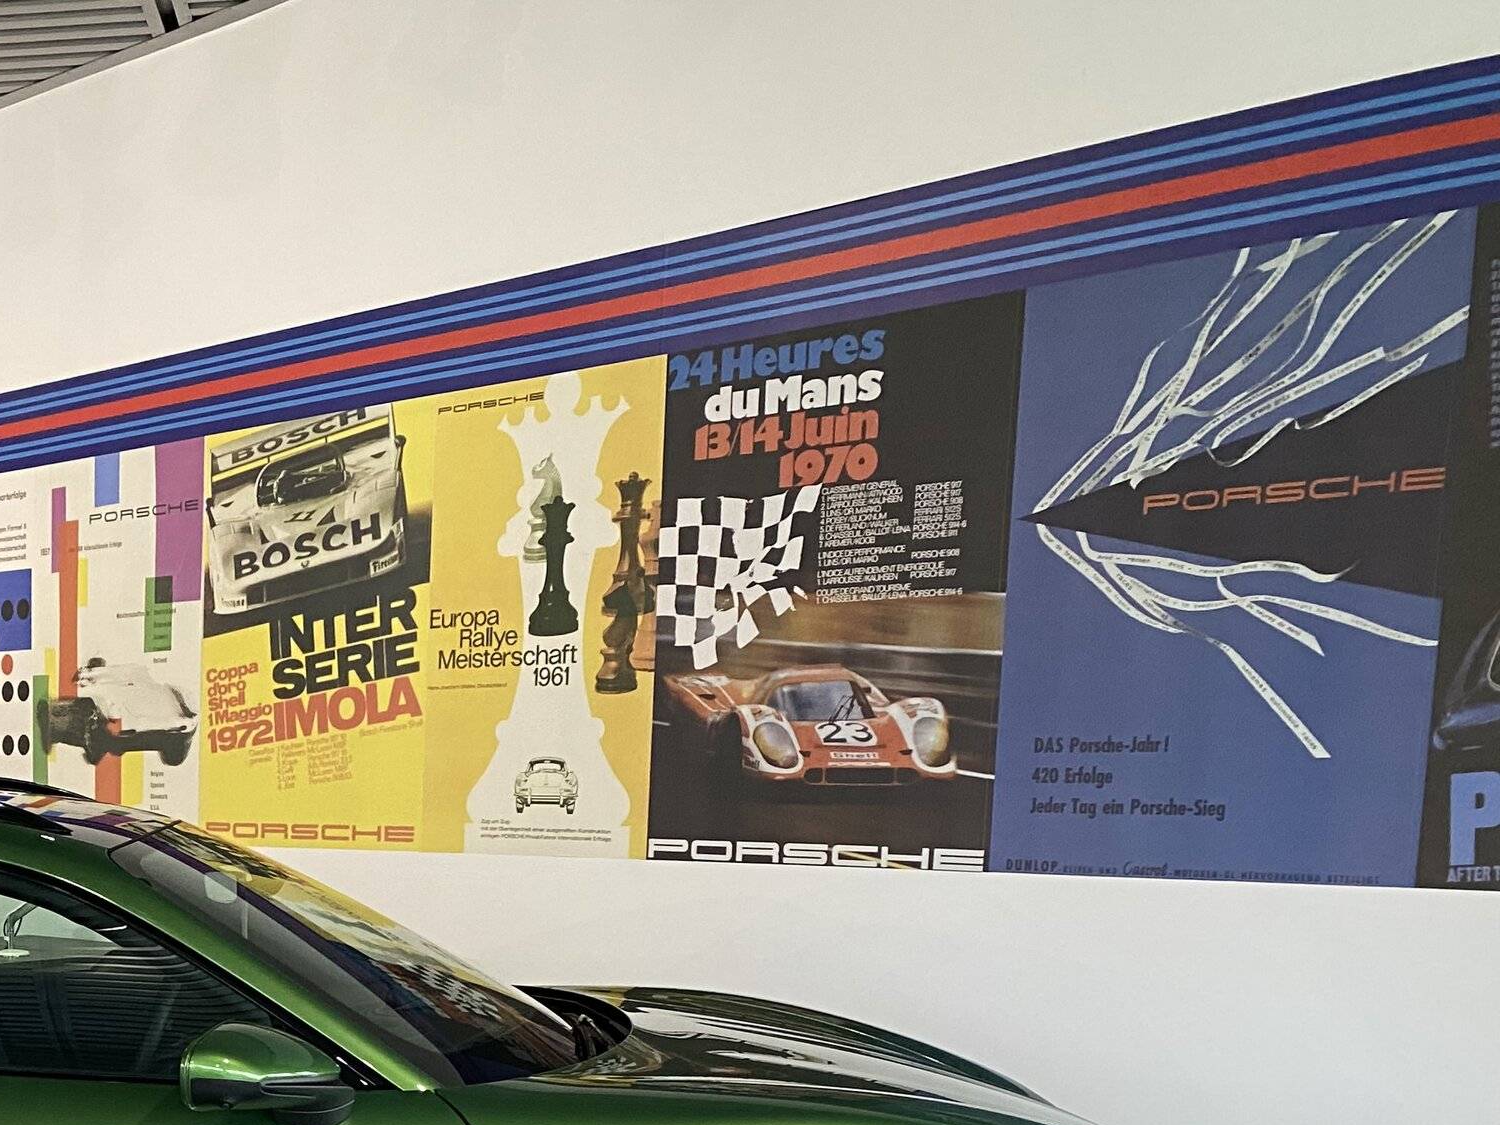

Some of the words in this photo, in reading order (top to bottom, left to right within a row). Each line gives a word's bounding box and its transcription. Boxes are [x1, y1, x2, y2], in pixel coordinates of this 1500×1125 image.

[667, 350, 717, 391] 24
[720, 329, 886, 383] Heures
[437, 391, 545, 415] PORSCHE
[704, 385, 760, 423] du
[764, 369, 885, 416] Mans
[230, 407, 368, 465] BOSCH
[693, 415, 784, 461] 13/14
[783, 405, 880, 450] Juin
[778, 442, 879, 489] 1970
[914, 490, 950, 501] PORSCHE
[915, 482, 950, 493] PORSCHE
[1142, 467, 1447, 516] PORSCHE
[88, 499, 200, 525] PORSCHE
[914, 498, 950, 509] PORSCHE
[912, 521, 949, 532] PORSCHE
[912, 529, 948, 540] PORSCHE
[233, 512, 382, 581] BOSCH
[911, 549, 946, 559] PORSCHE
[910, 569, 945, 579] PORSCHE
[909, 588, 945, 598] PORSCHE
[268, 585, 419, 662] INTER
[429, 608, 500, 631] Europa
[459, 627, 519, 651] Rallye
[271, 631, 421, 700] SERIE
[438, 643, 578, 670] Meisterschaft
[206, 662, 259, 683] Coppa
[533, 666, 570, 687] 1961
[208, 691, 246, 712] Shell
[273, 675, 423, 742] IMOLA
[214, 703, 273, 725] Maggio
[207, 719, 274, 754] 1972
[818, 722, 874, 744] 23
[1033, 737, 1063, 754] DAS
[1031, 767, 1059, 784] 420
[1064, 765, 1113, 789] Erfolge
[1030, 797, 1067, 815] Jeder
[1071, 798, 1097, 819] Tag
[1102, 799, 1124, 815] ein
[1130, 797, 1227, 822] Porsche-Sieg
[205, 821, 416, 843] PORSCHE
[647, 838, 986, 872] PORSCHE
[1446, 865, 1491, 883] AFTER
